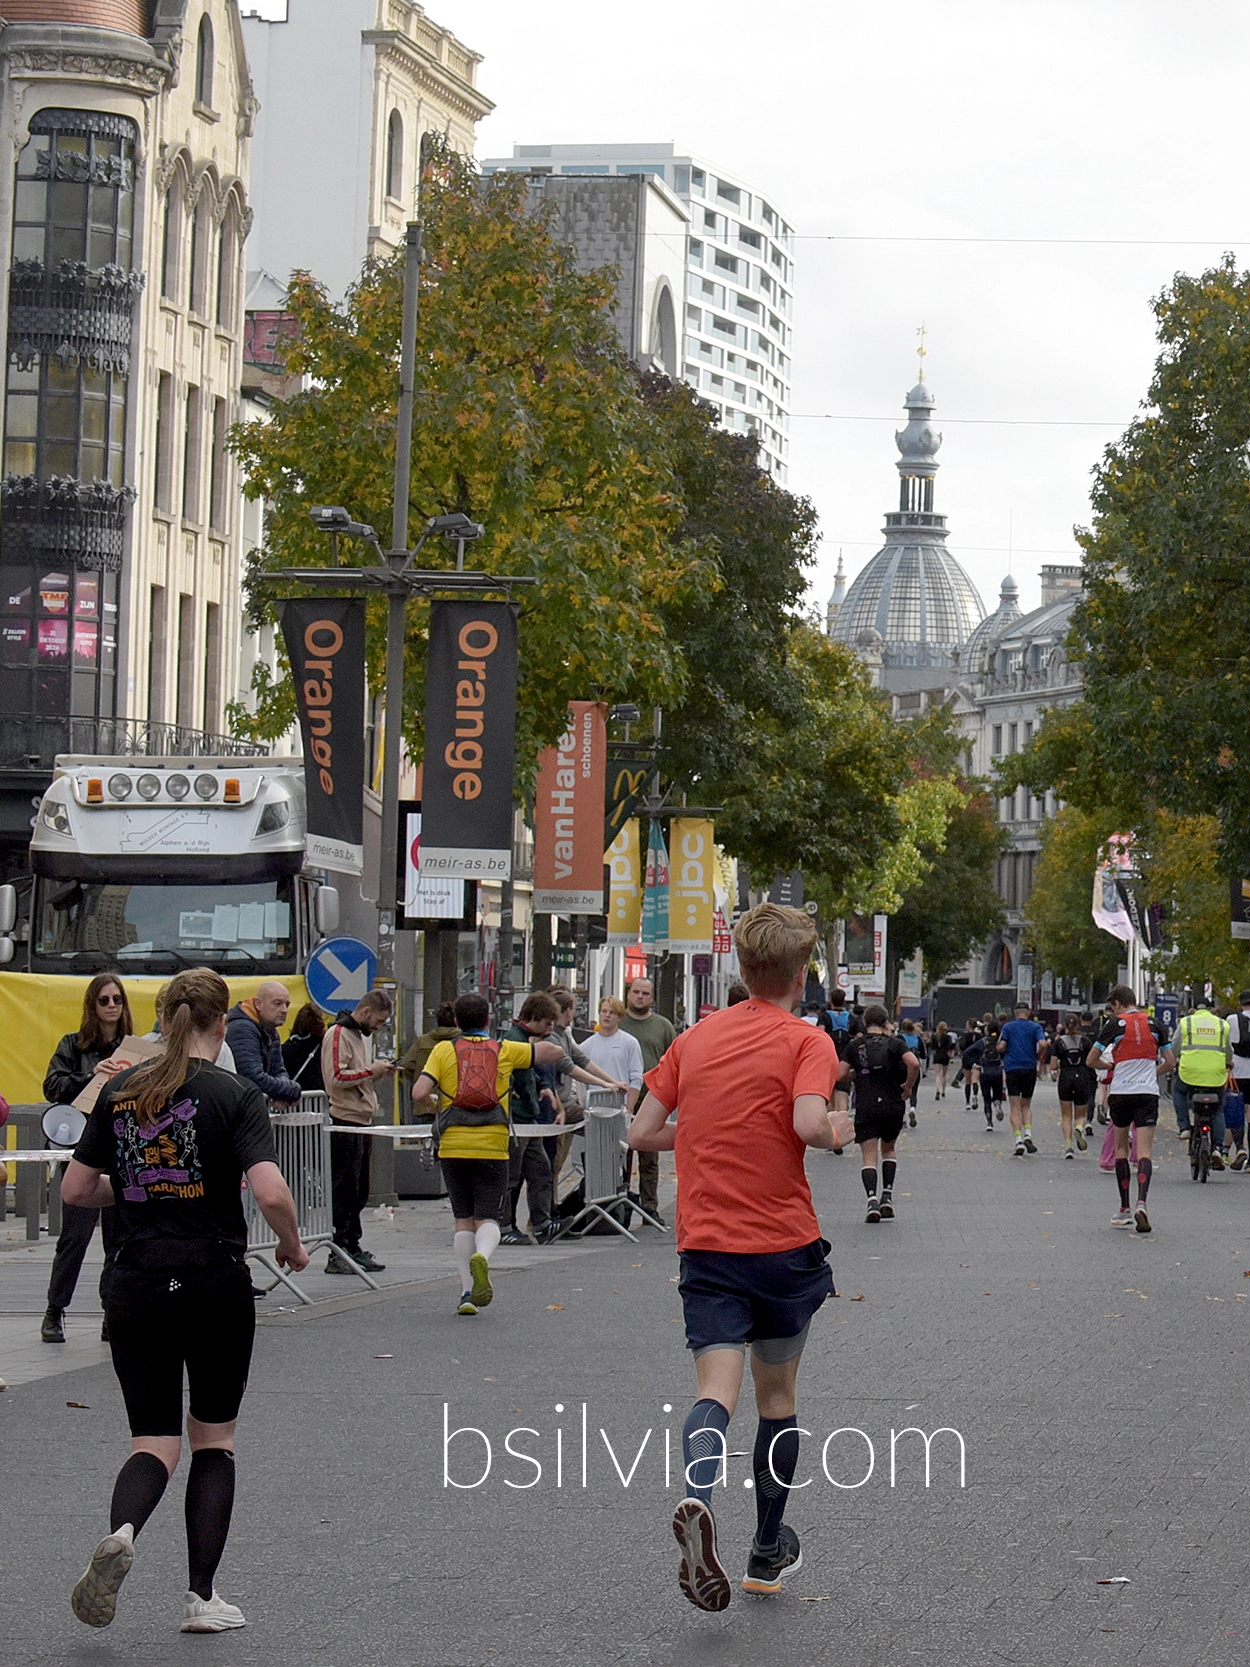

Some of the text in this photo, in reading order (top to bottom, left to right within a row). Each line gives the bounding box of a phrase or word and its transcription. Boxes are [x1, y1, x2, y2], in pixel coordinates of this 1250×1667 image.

[304, 619, 344, 795] Orange
[445, 620, 498, 800] Orange
[580, 712, 593, 778] schoenen
[313, 841, 356, 862] meir-as.be
[424, 856, 506, 870] meir-as.be
[675, 833, 709, 904] jbc
[542, 894, 594, 905] meir-as.be
[1163, 1010, 1172, 1022] 8
